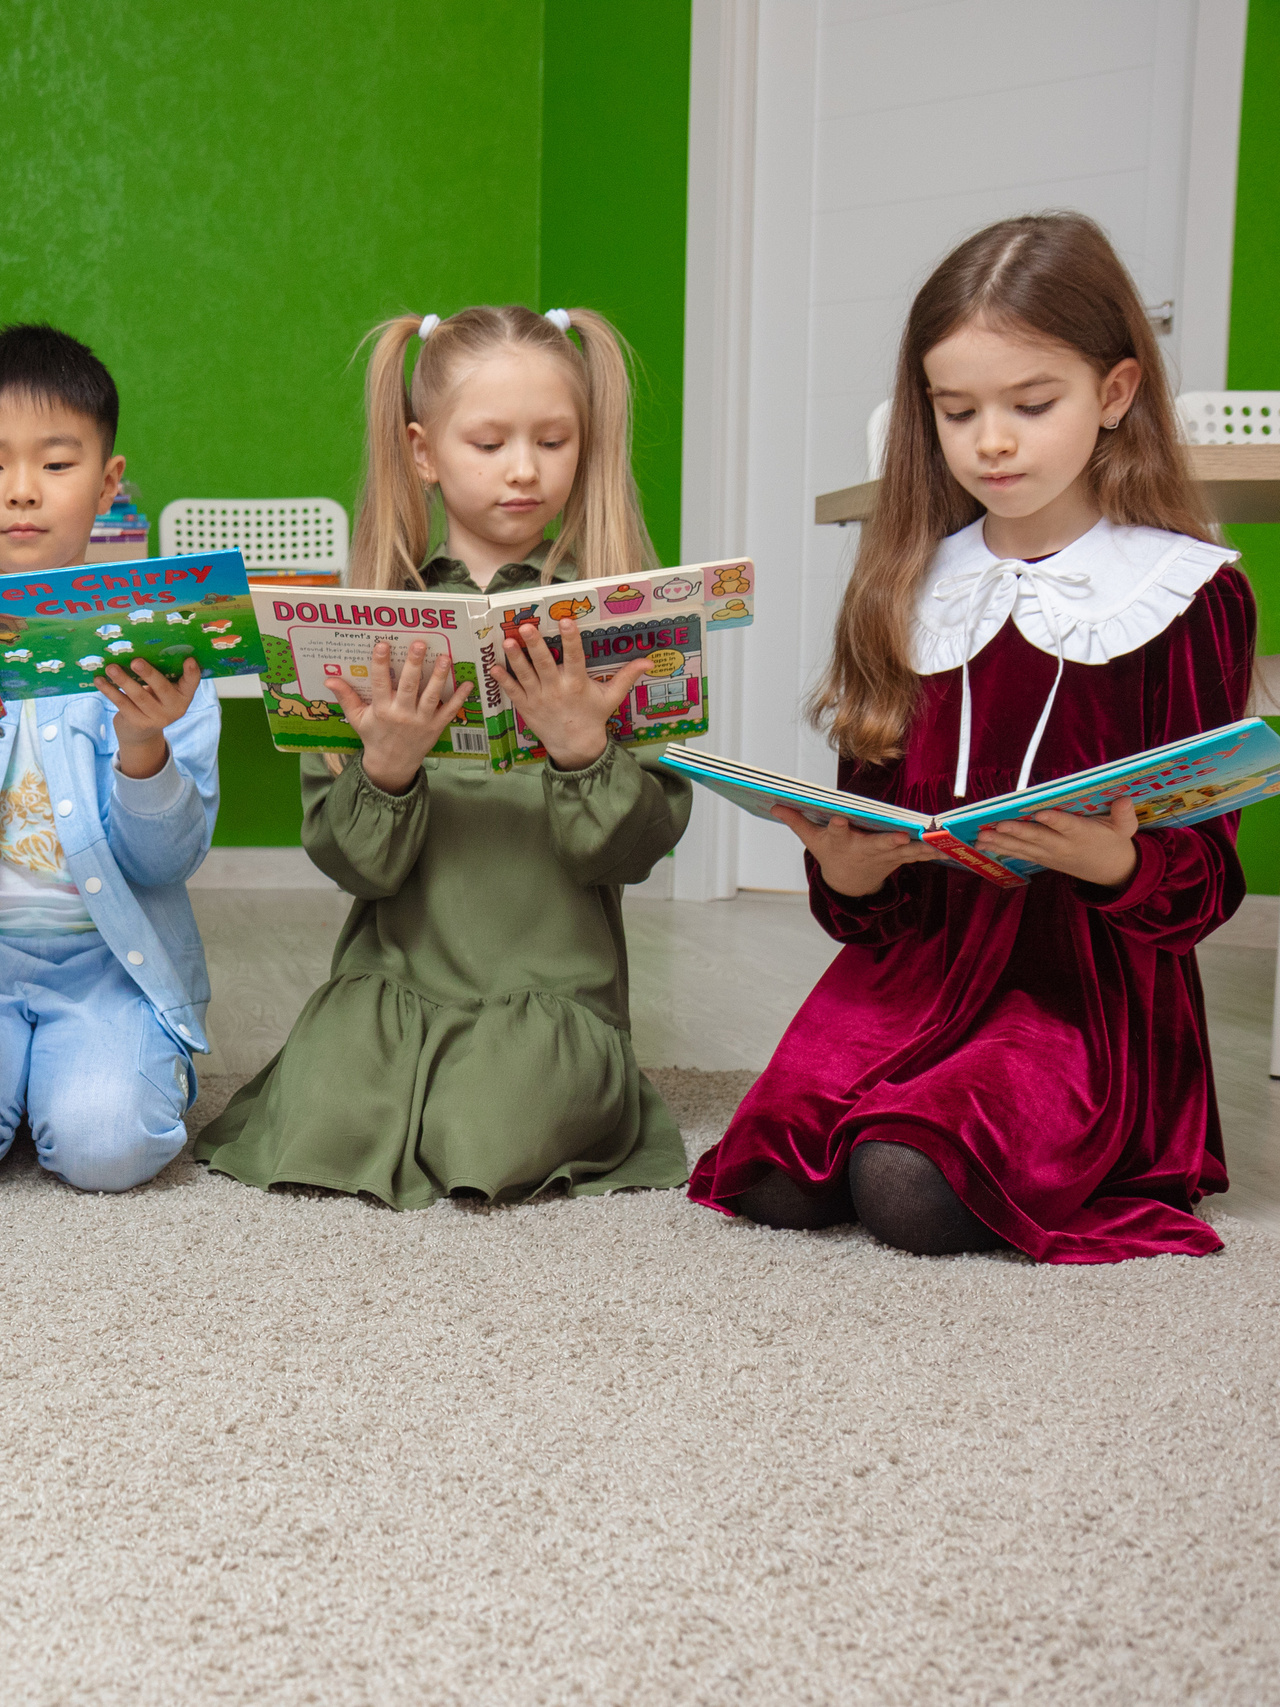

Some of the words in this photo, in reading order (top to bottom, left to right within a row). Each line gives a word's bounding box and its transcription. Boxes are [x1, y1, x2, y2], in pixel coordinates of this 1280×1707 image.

[71, 565, 214, 592] Chirpy
[35, 590, 177, 616] Chicks
[273, 600, 457, 629] DOLLHOUSE
[334, 632, 371, 640] Parent's
[375, 634, 399, 643] guide
